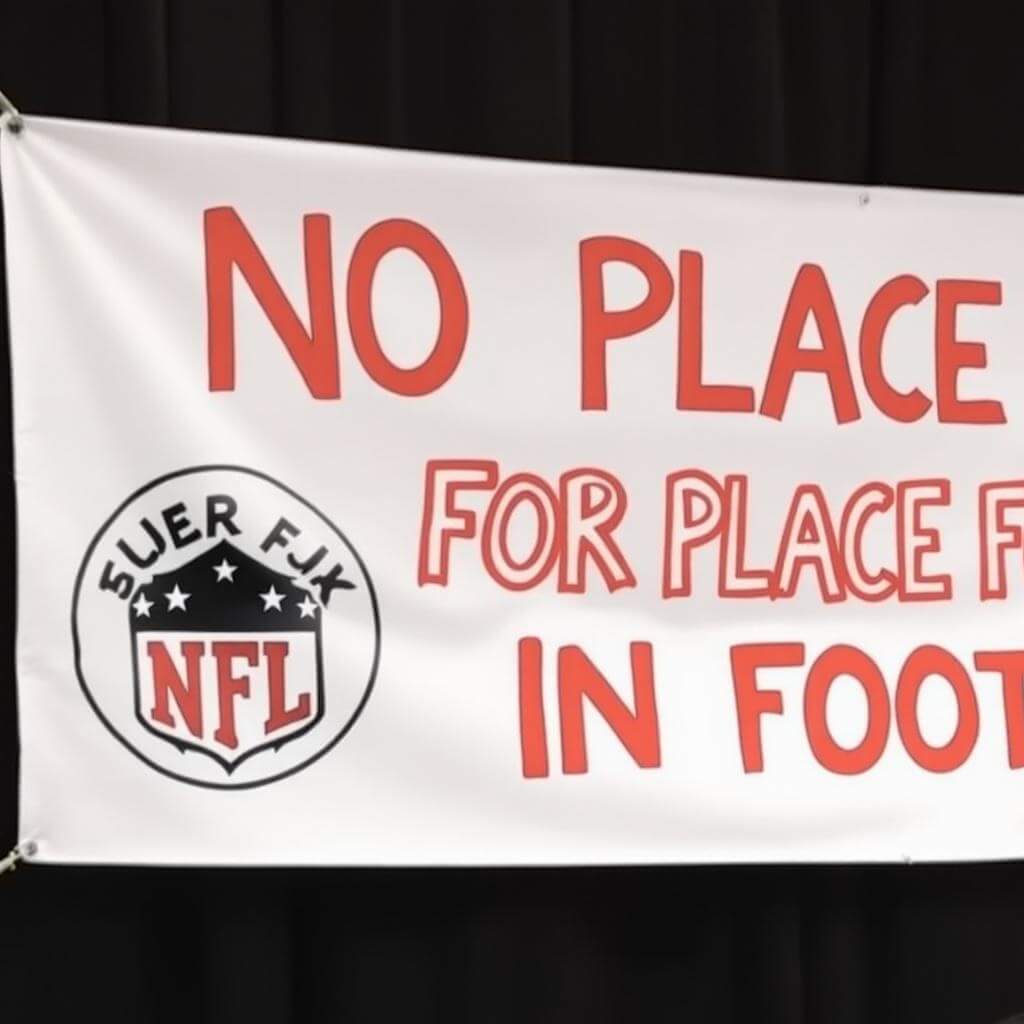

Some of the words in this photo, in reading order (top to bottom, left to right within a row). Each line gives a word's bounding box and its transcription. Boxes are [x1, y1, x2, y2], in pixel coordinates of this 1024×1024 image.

[202, 205, 471, 402] NO
[578, 233, 1008, 427] PLACE
[416, 457, 638, 596] FOR
[660, 467, 954, 606] PLACE
[146, 640, 312, 750] NFL
[517, 635, 663, 780] IN
